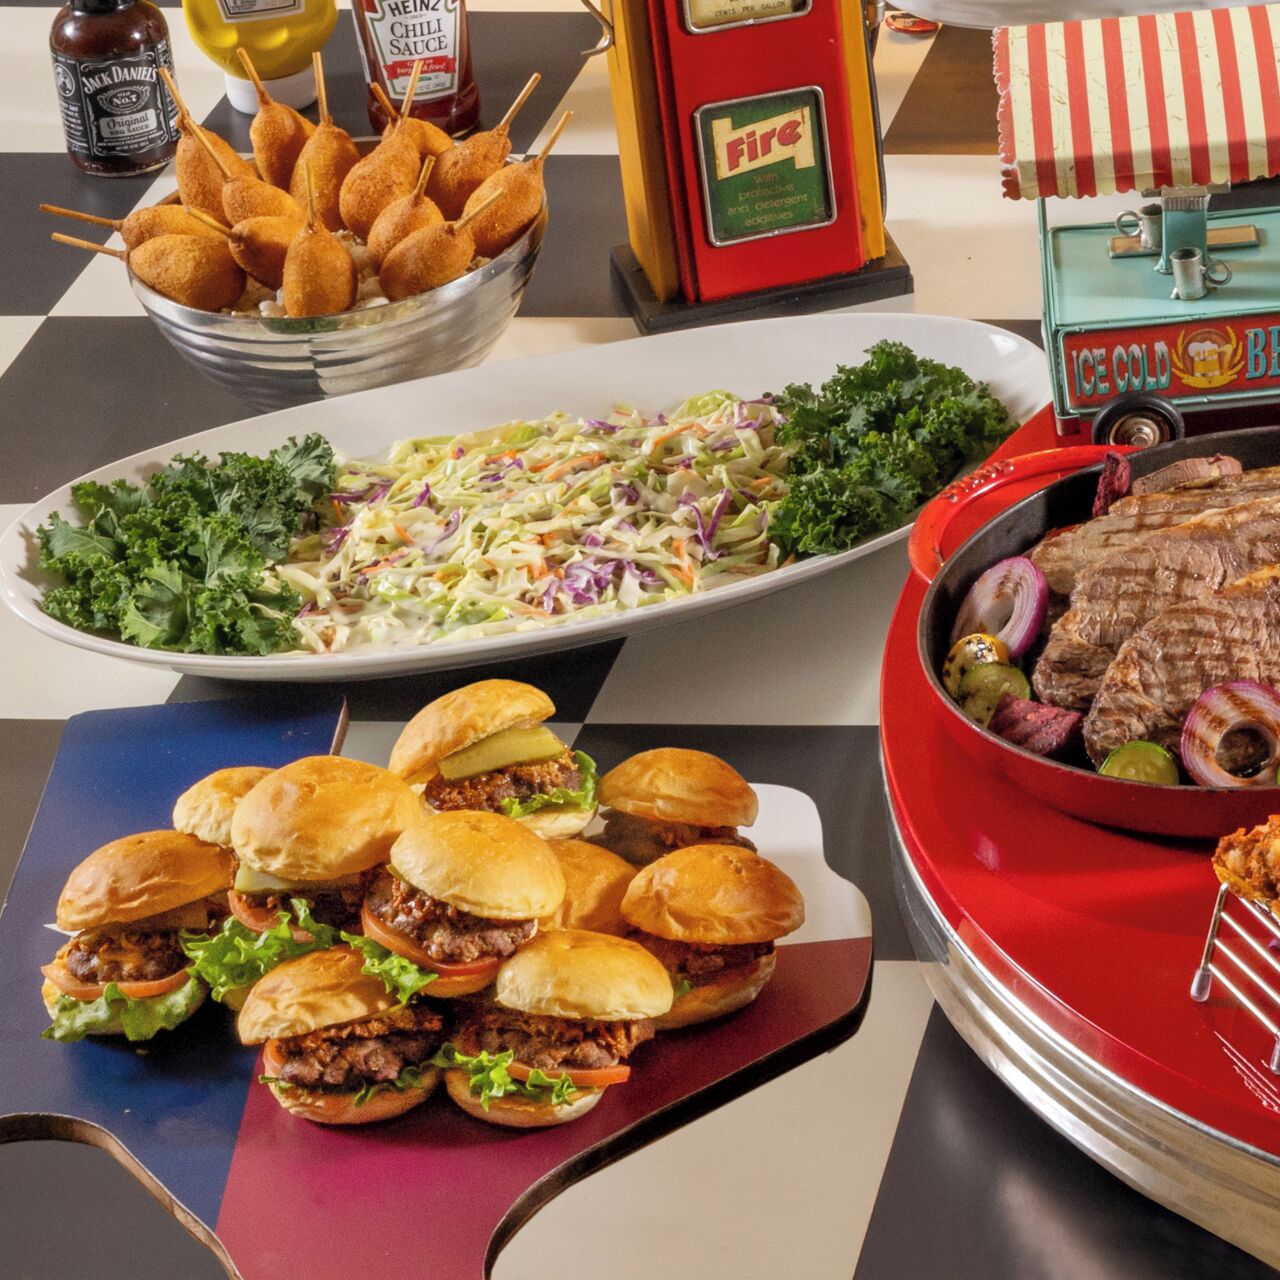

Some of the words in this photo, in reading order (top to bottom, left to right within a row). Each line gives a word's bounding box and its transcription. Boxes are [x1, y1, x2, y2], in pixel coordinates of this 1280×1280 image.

[715, 7, 736, 17] CENTS
[82, 72, 112, 94] JACK
[112, 64, 158, 83] DANIEL'S
[107, 113, 149, 130] Original
[726, 119, 801, 172] Fire
[738, 183, 794, 202] protective
[727, 204, 749, 217] and
[755, 193, 808, 212] detergent
[1071, 348, 1109, 397] ICE
[1112, 341, 1170, 394] COLD
